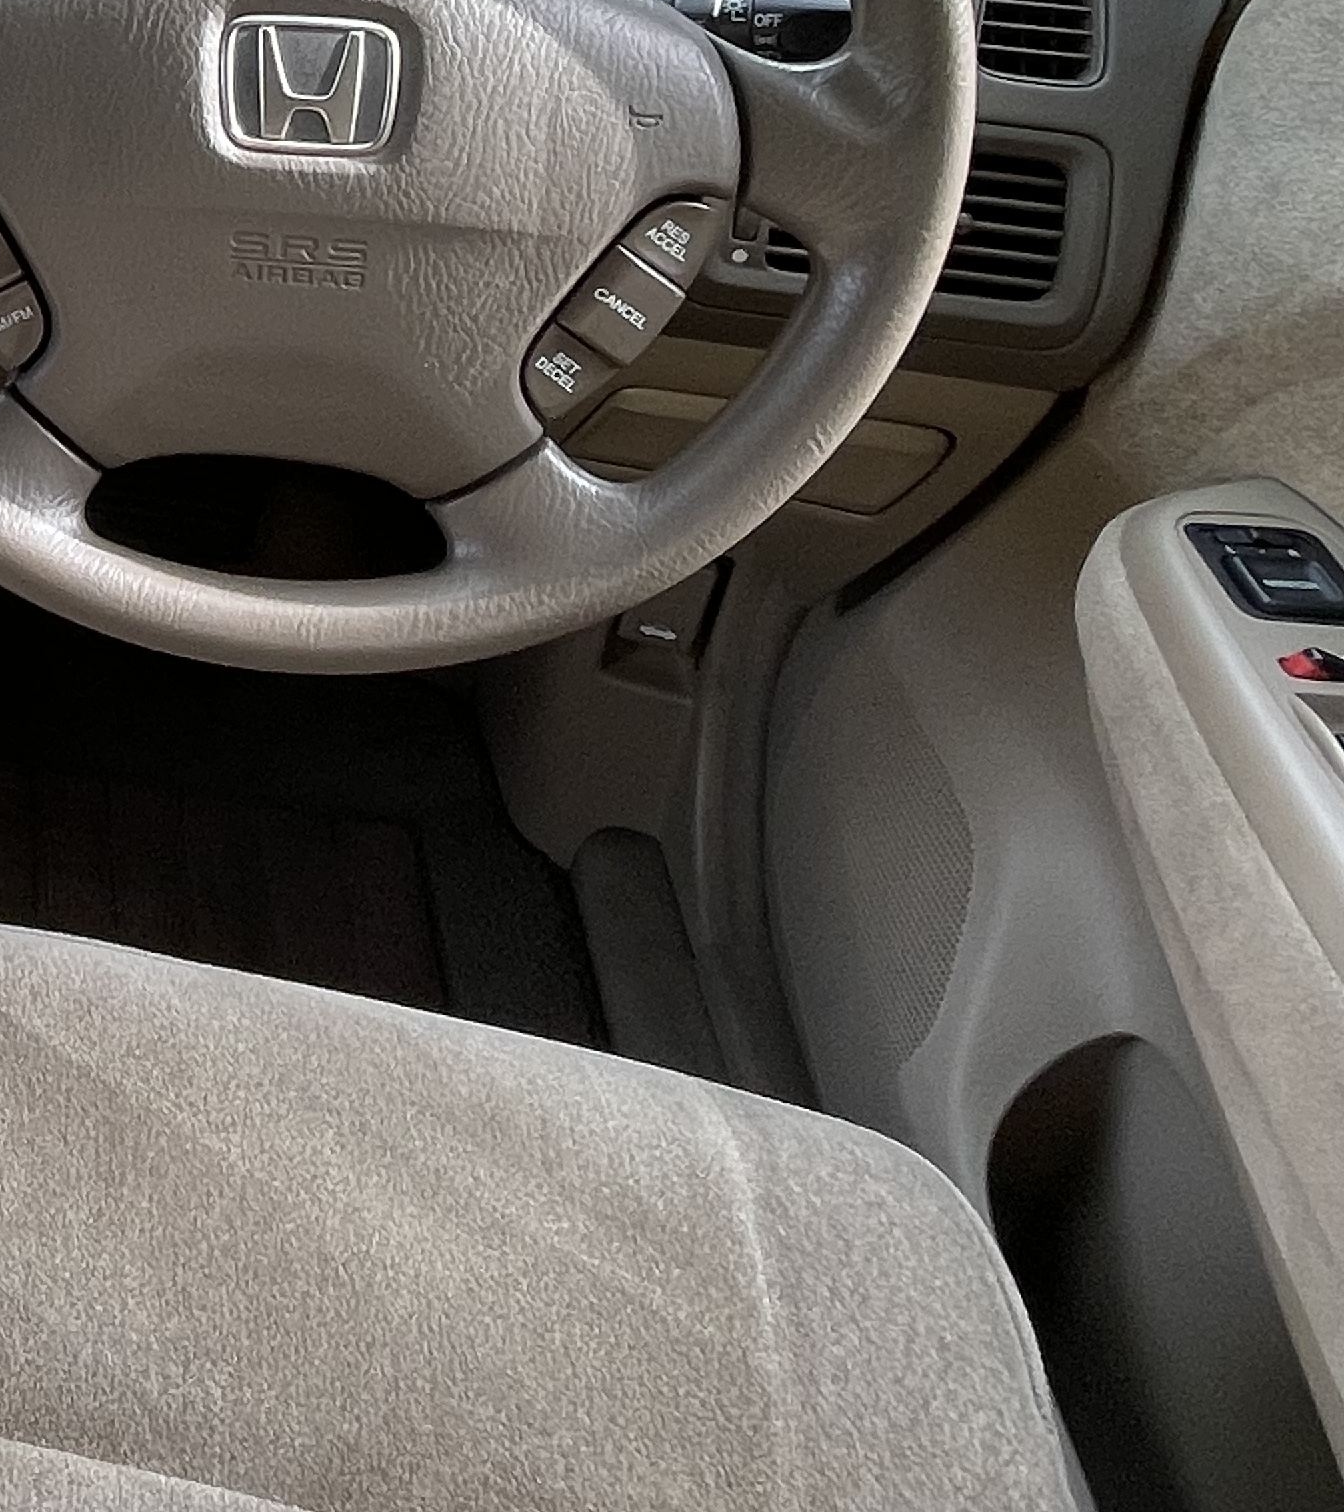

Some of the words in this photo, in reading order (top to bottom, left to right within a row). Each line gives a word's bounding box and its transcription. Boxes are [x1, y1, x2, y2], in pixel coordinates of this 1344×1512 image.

[753, 13, 784, 29] OFF
[230, 230, 368, 262] SRS
[645, 227, 688, 262] ACCEL
[661, 219, 690, 245] RES
[232, 262, 366, 290] AIRBAG
[594, 287, 647, 331] CANCEL
[535, 356, 576, 394] DECEL
[552, 352, 582, 375] SET
